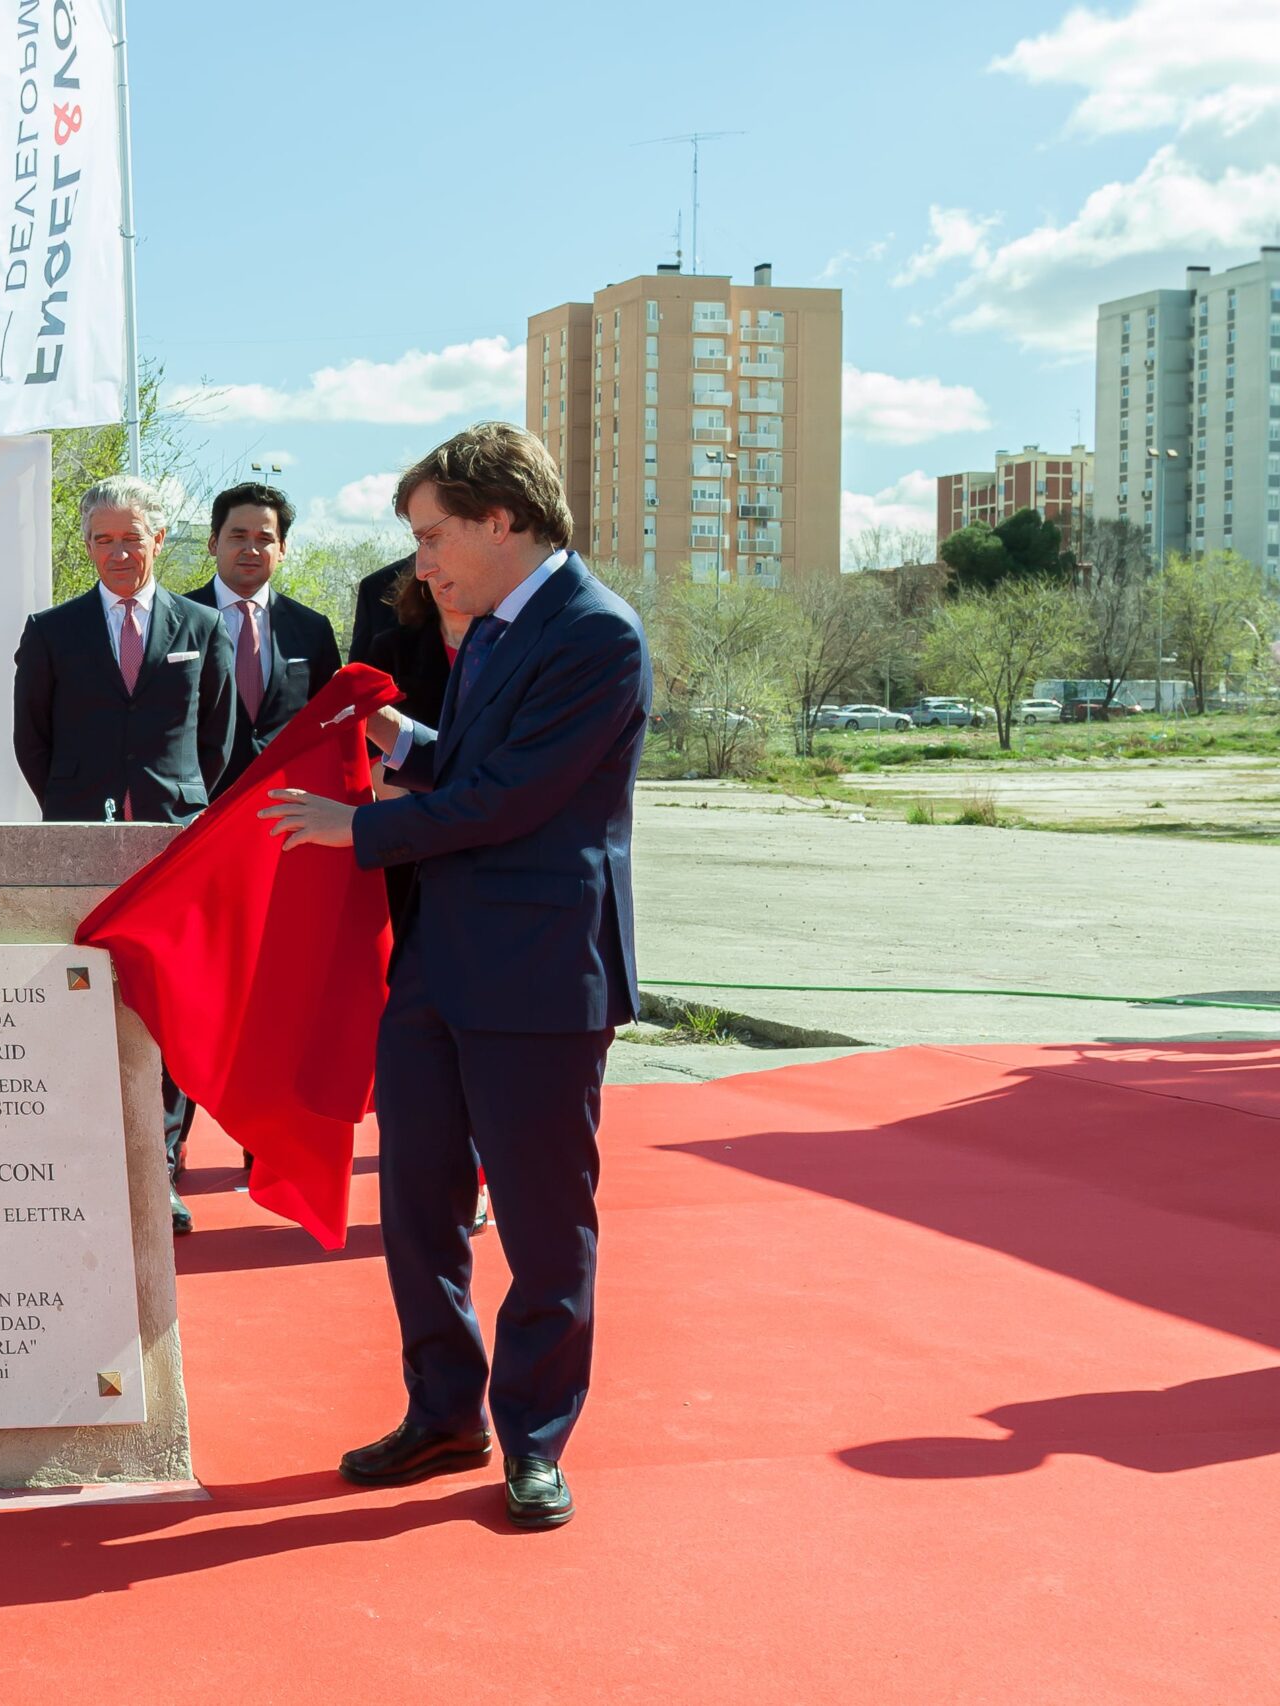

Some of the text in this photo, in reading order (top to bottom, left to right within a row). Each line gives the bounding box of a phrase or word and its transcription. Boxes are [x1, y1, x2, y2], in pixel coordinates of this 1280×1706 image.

[1, 987, 46, 1004] LUIS
[4, 1206, 86, 1223] ELETTRA
[16, 1291, 65, 1308] PARA
